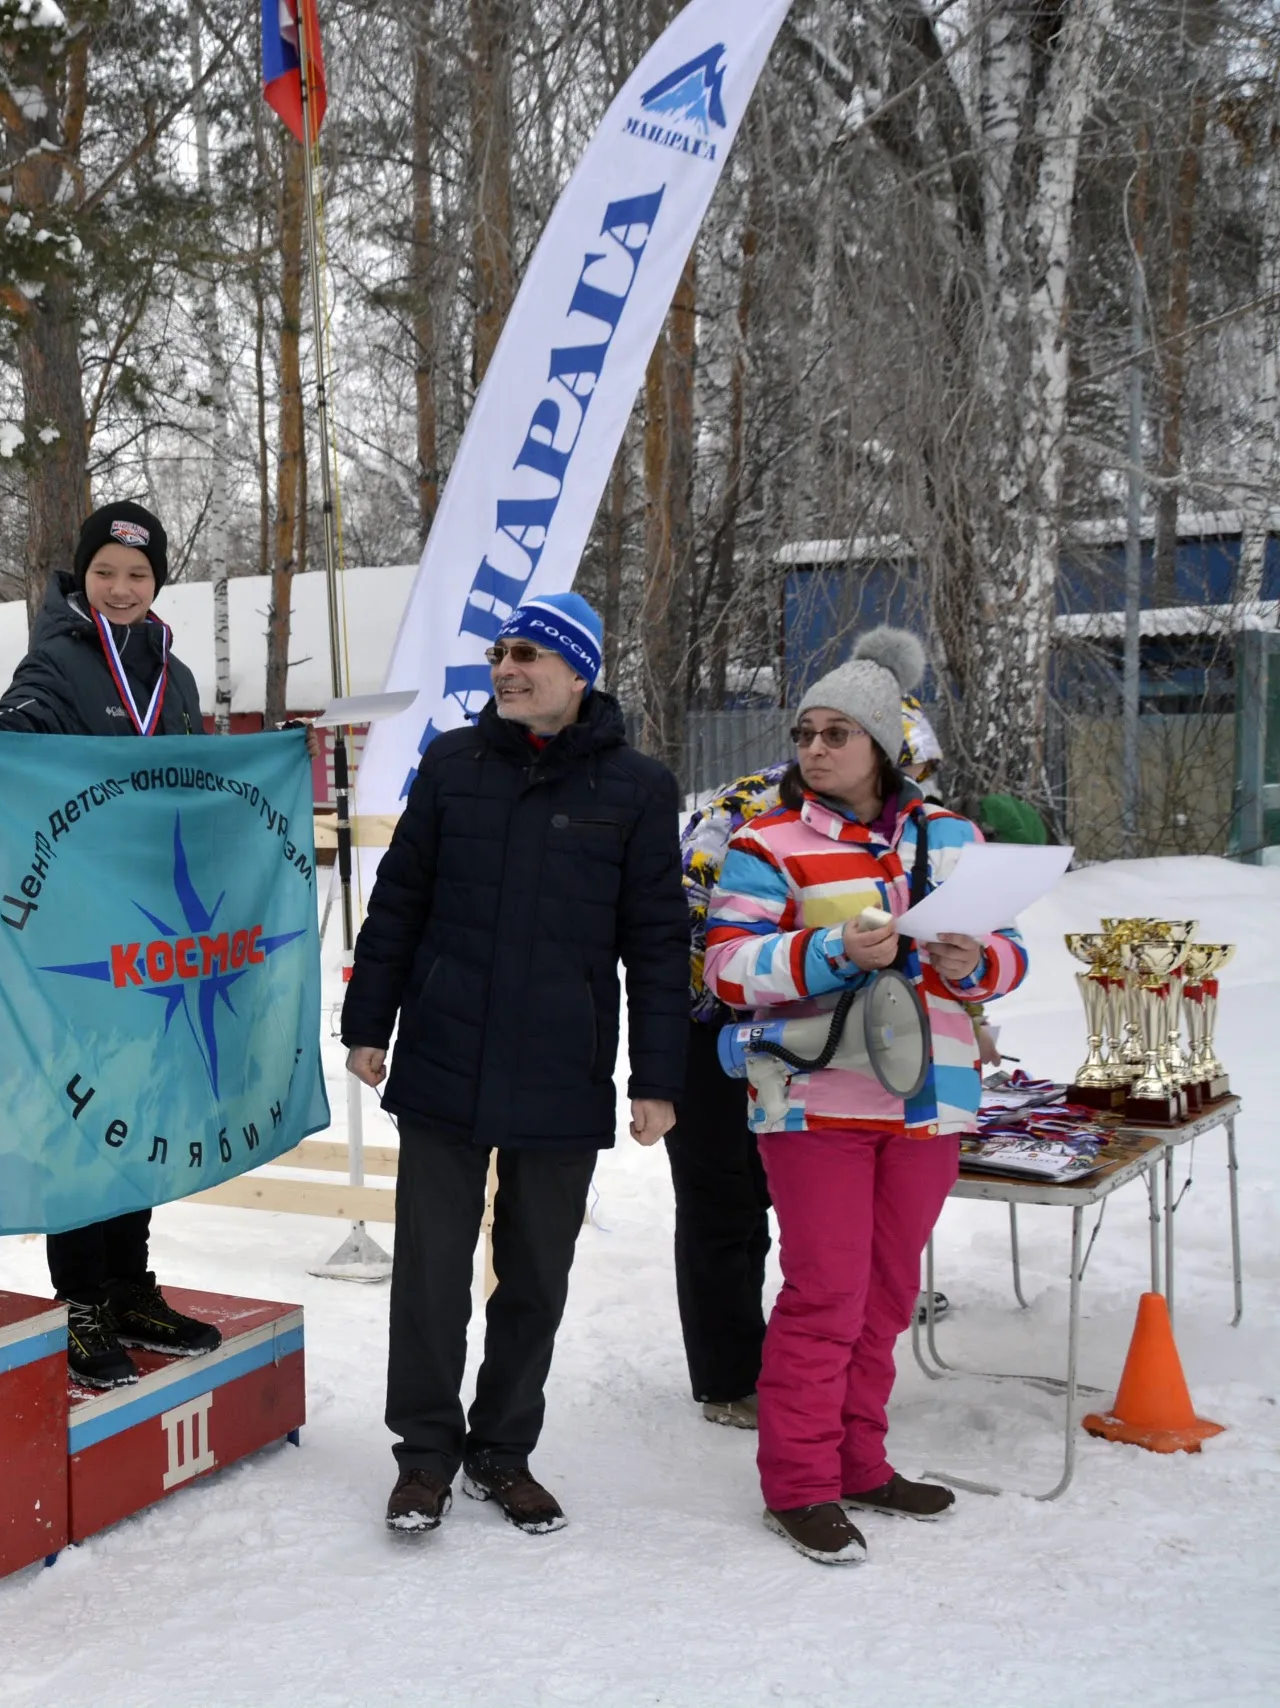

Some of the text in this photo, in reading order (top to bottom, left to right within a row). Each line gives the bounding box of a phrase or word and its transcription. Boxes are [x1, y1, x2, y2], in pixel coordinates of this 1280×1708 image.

[622, 117, 717, 161] МАНАРАГА
[398, 182, 666, 801] АНАРАГА
[0, 830, 58, 931] Центр
[259, 797, 313, 896] турзм
[111, 925, 266, 989] КОСМОС
[66, 1049, 303, 1168] Челябин
